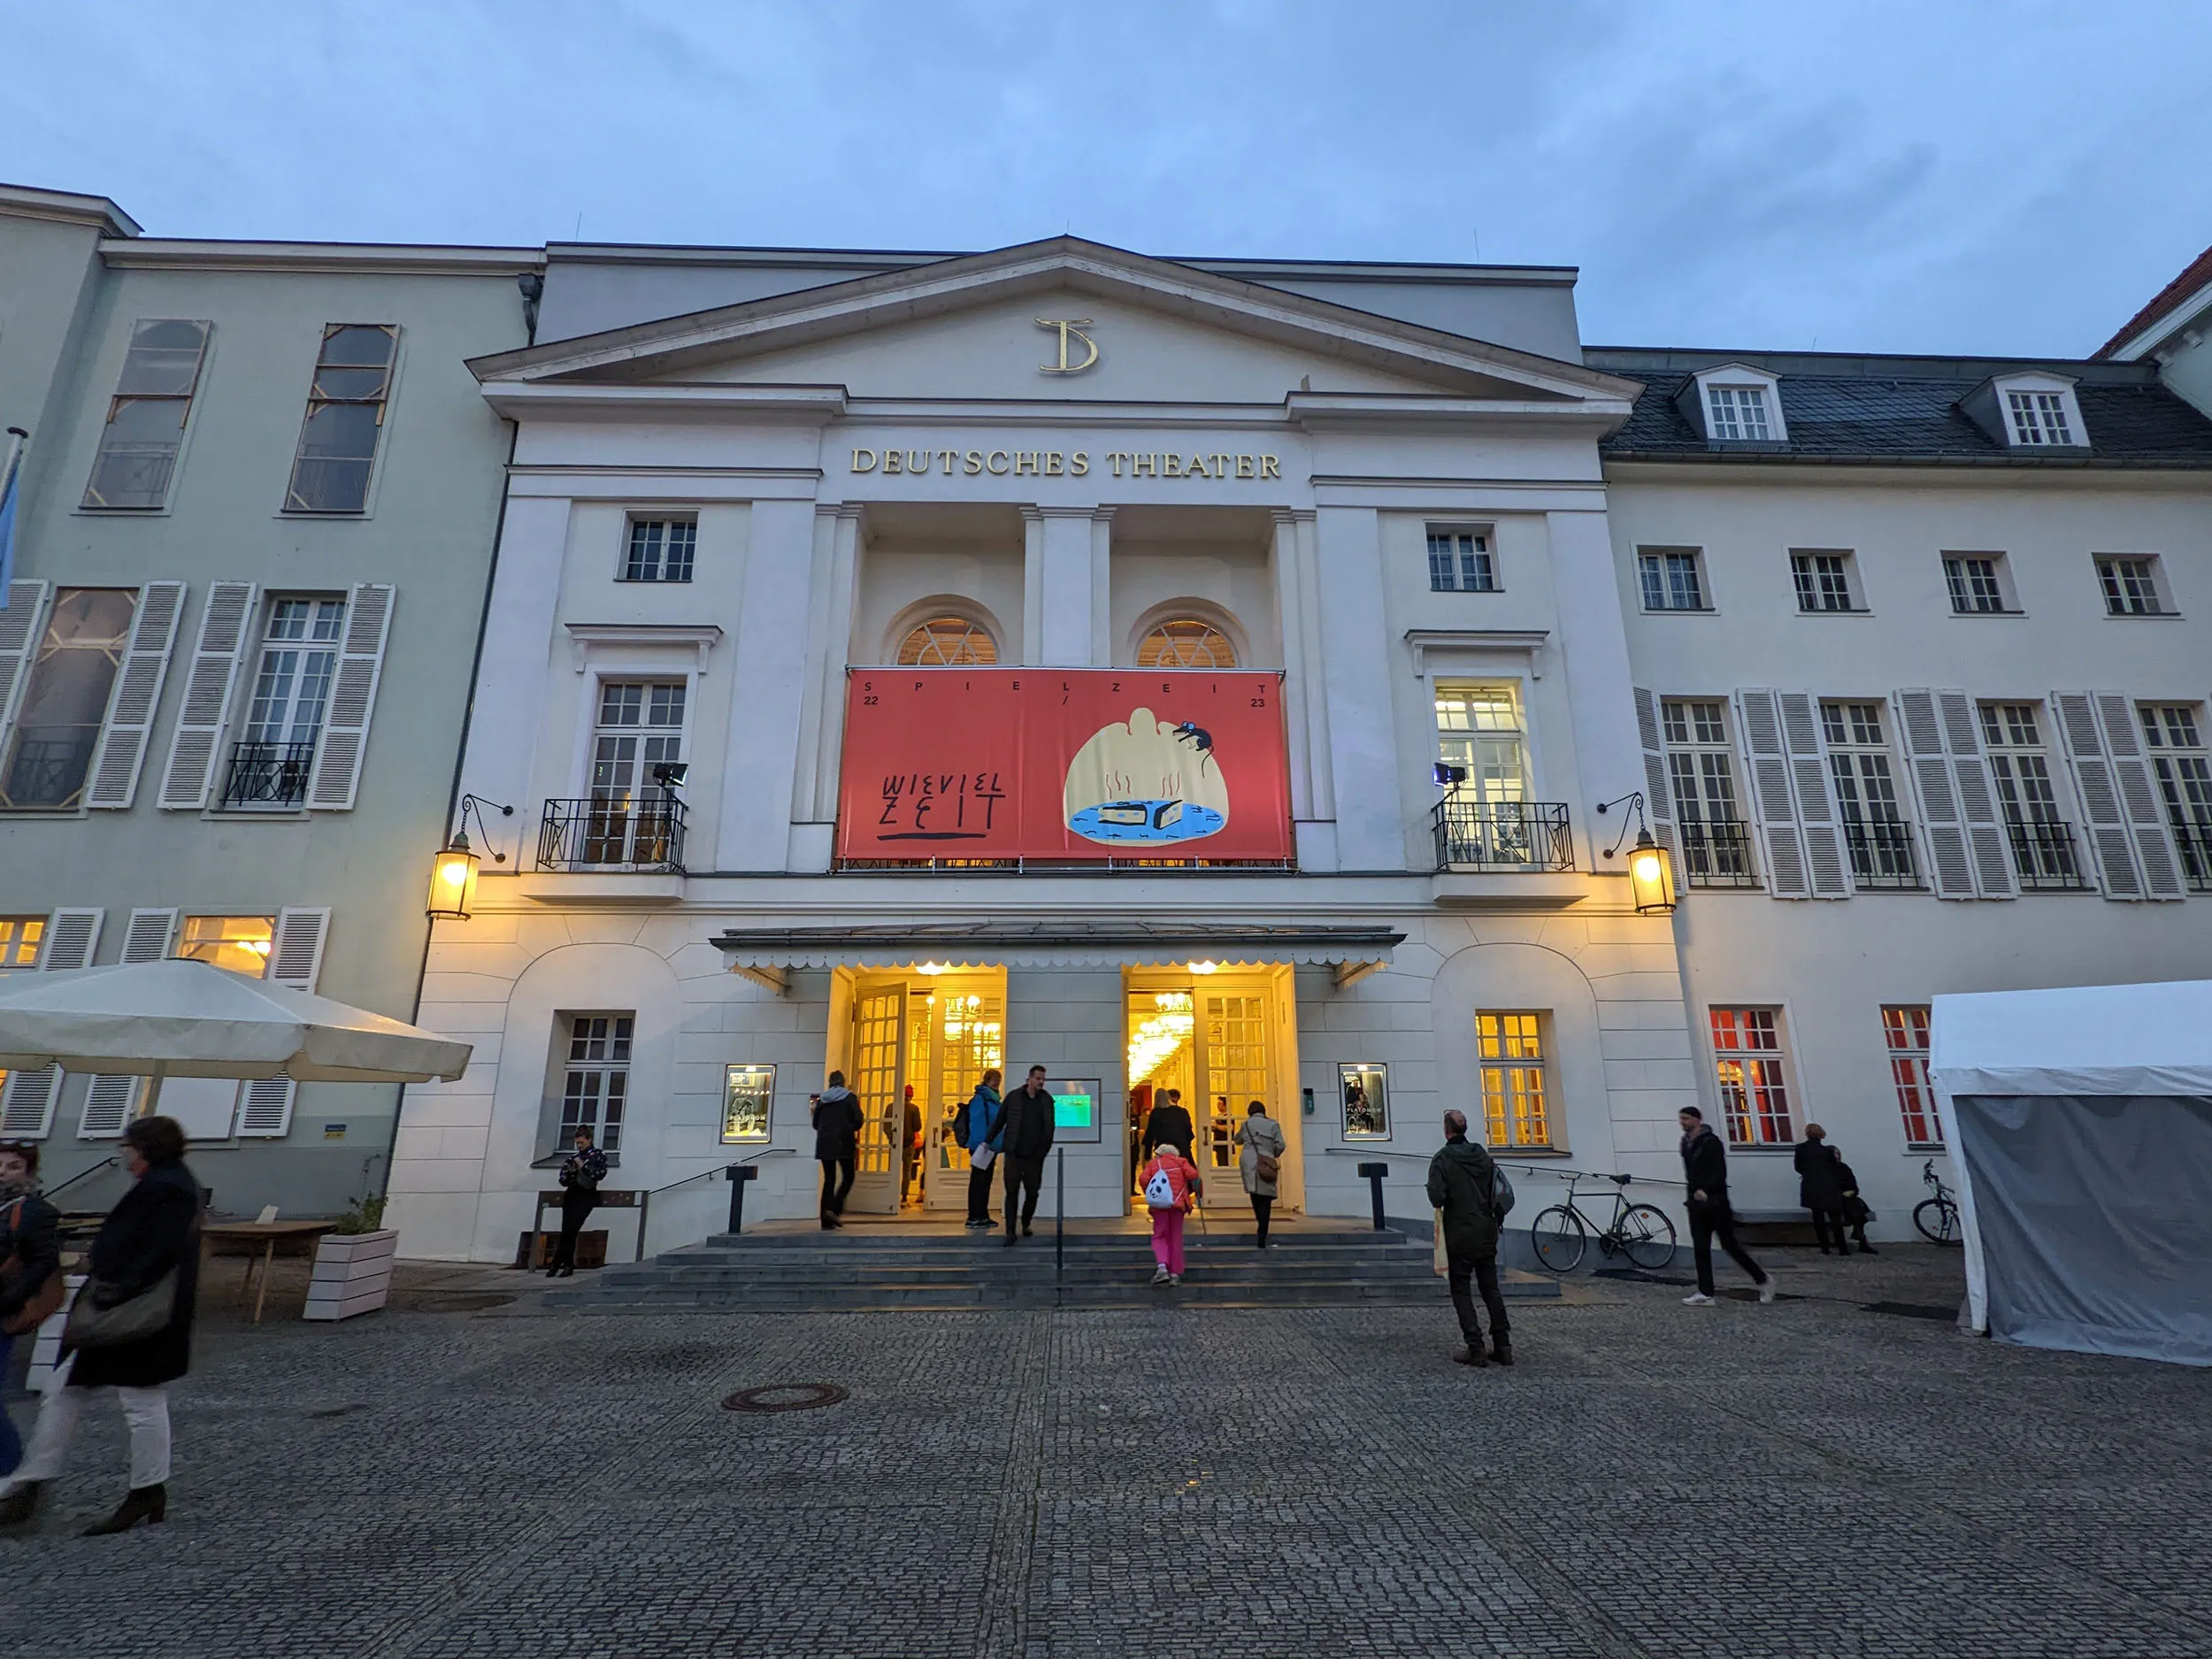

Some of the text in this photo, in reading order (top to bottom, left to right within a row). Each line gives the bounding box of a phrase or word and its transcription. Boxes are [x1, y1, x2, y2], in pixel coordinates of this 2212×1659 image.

[850, 448, 1281, 478] DEUTSCHES THEATER
[864, 695, 879, 705] 22
[1250, 698, 1265, 708] 23
[882, 772, 1002, 795] WIEVIEL
[879, 794, 1006, 830] ZEIT
